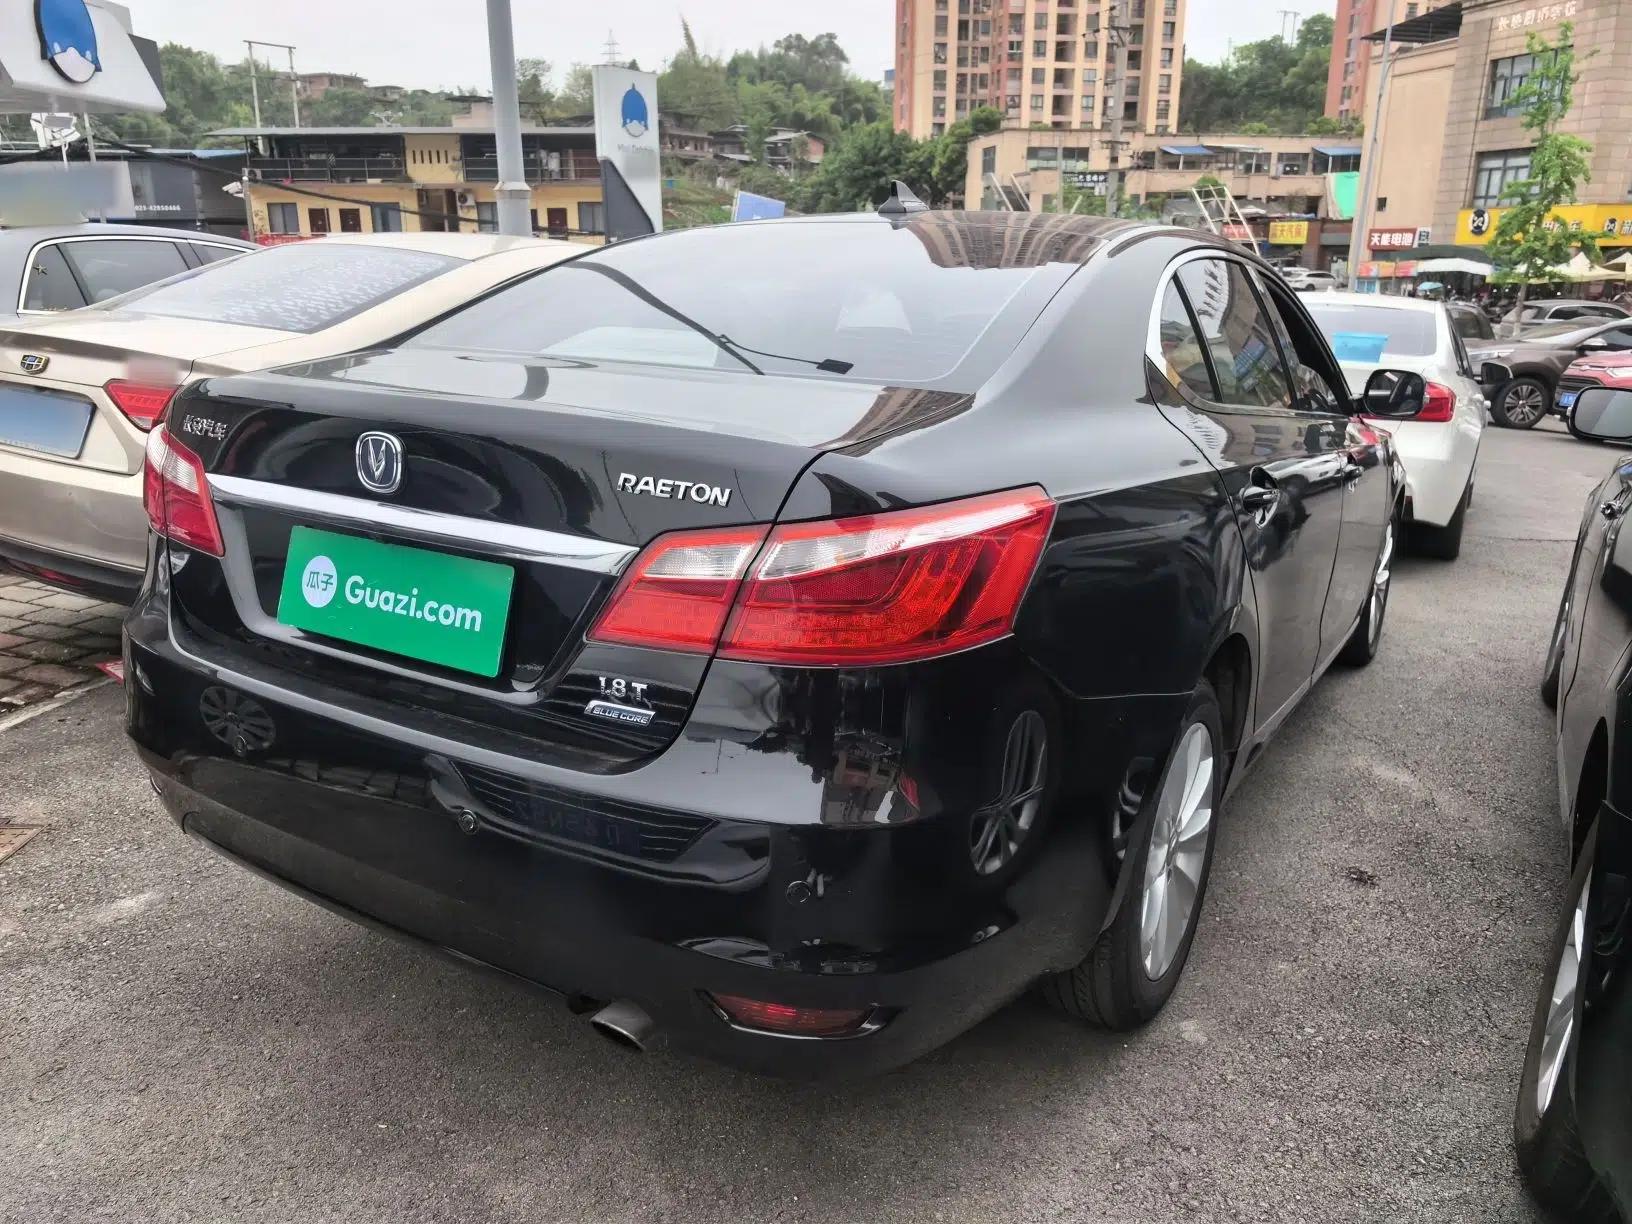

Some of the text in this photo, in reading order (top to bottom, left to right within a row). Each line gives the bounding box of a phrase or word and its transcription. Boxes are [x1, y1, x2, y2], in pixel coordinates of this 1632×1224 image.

[1370, 232, 1414, 246] 天能电池
[183, 414, 228, 441] 长安汽车
[617, 472, 732, 507] RAETON
[593, 706, 650, 724] BLUE CORE
